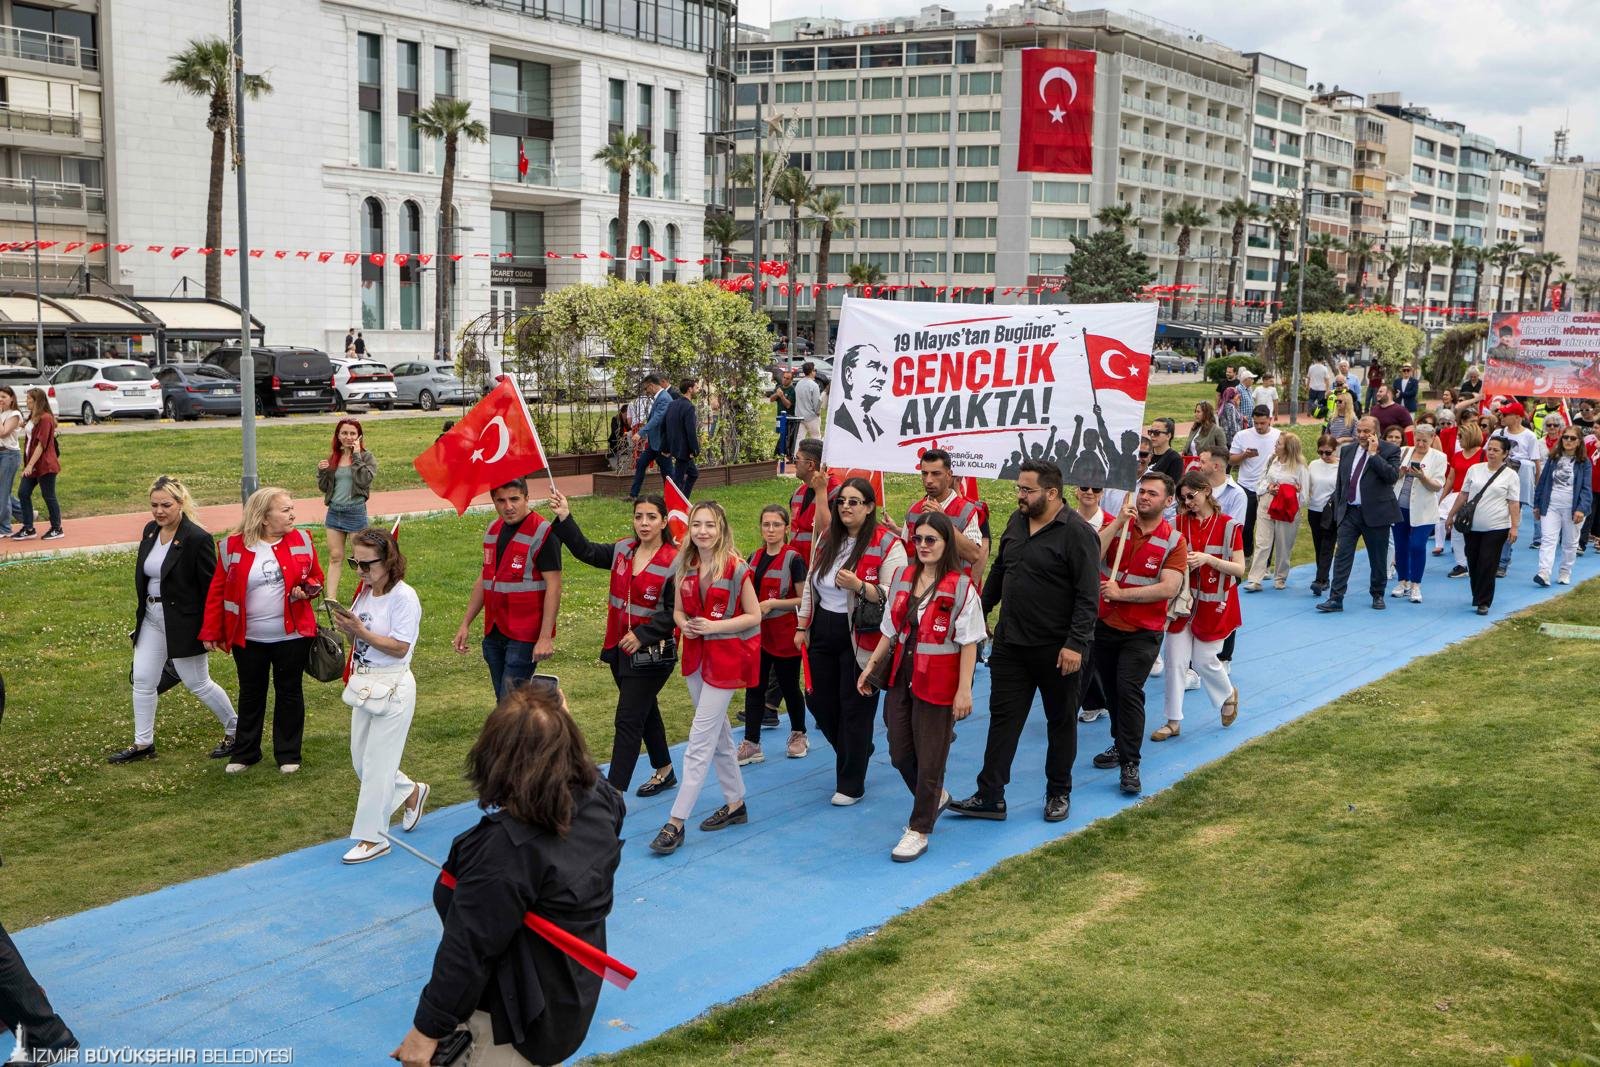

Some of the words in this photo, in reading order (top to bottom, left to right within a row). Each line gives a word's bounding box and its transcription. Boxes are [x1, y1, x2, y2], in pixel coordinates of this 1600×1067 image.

[893, 333, 911, 353] 19
[994, 322, 1056, 346] Bugüne:
[892, 342, 1059, 397] GENÇLİK
[899, 386, 1053, 436] AYAKTA!
